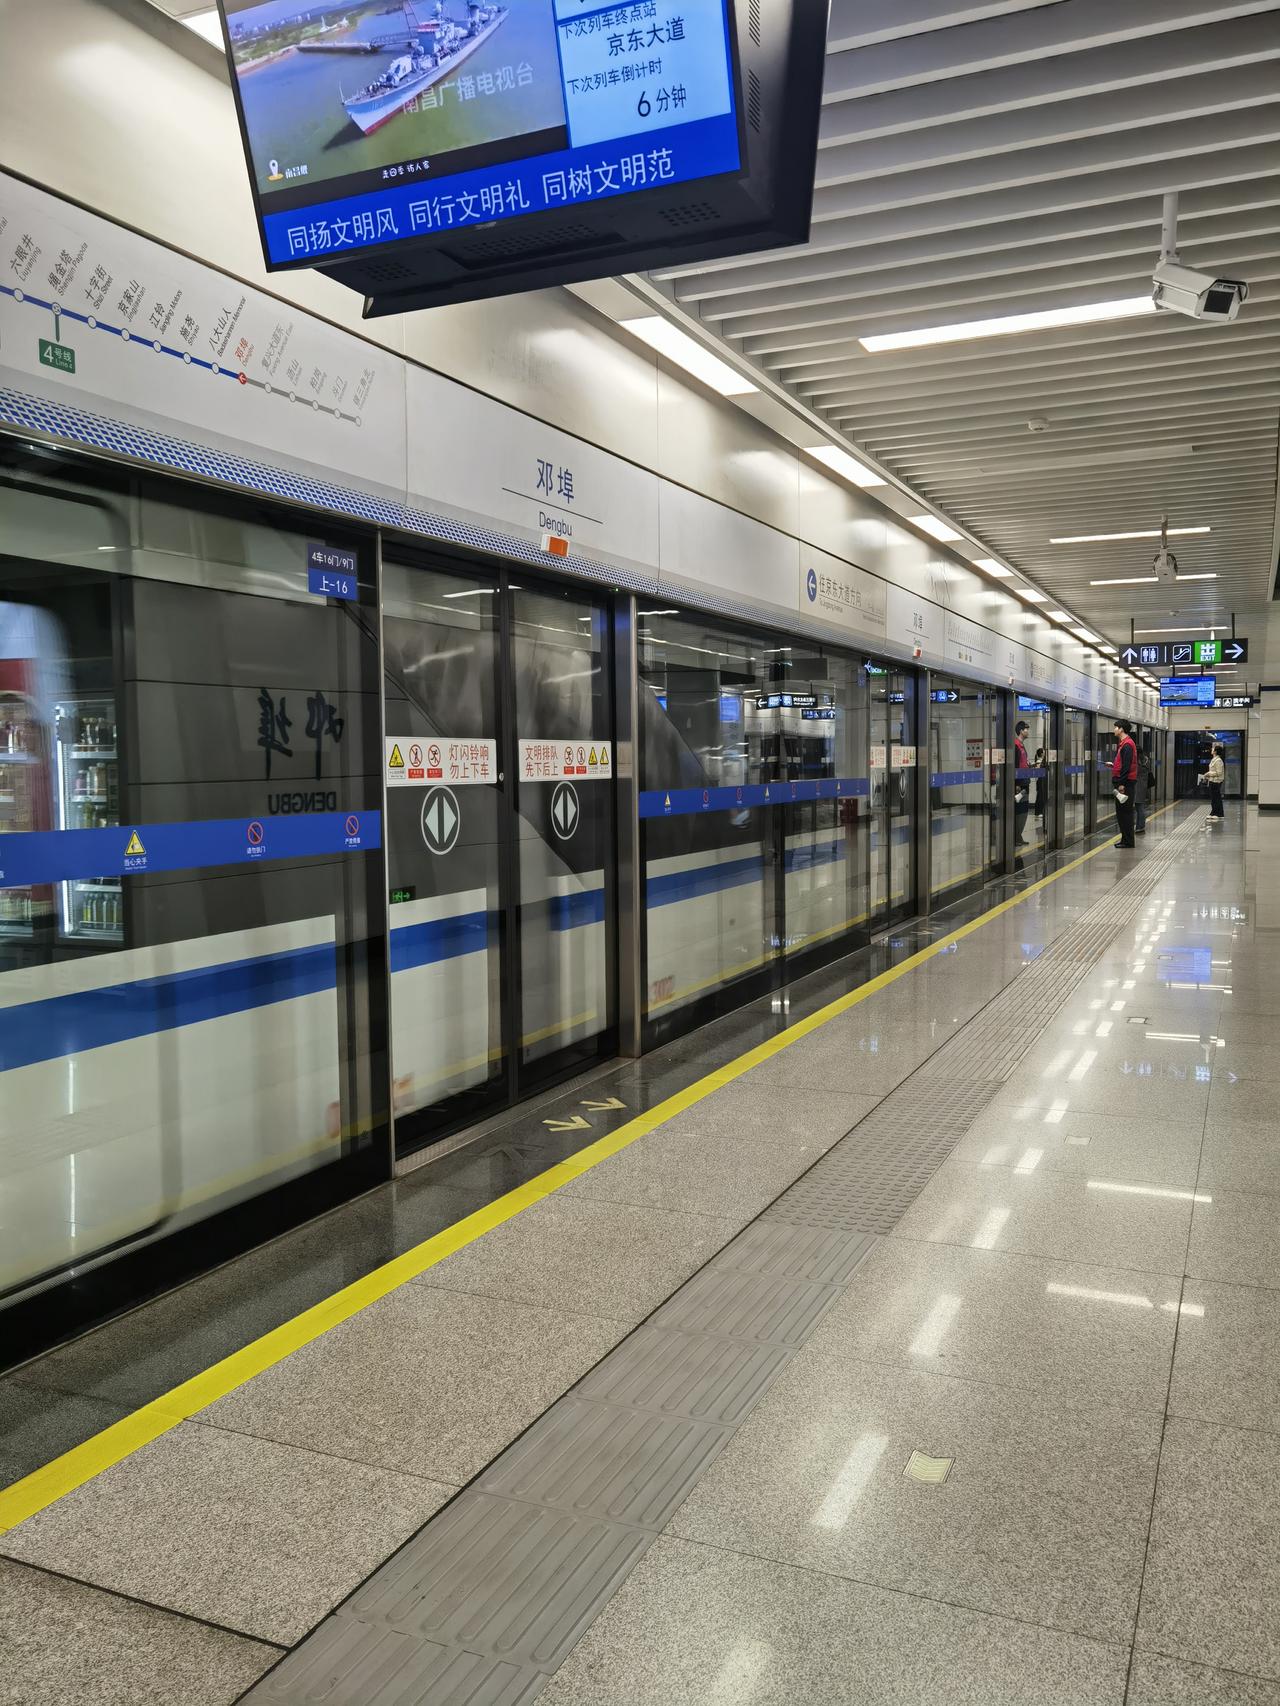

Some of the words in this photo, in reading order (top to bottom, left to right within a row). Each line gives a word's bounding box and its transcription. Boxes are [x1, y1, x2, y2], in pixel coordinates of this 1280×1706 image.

[560, 2, 657, 40] 下次列车终点站
[606, 16, 686, 57] 京东大道
[402, 61, 534, 115] 南昌广播电视台
[567, 57, 663, 95] 下次列车倒计时
[637, 91, 651, 118] 6
[656, 83, 687, 114] 分钟
[287, 207, 399, 256] 同扬文明风
[408, 180, 530, 231] 同行文明礼
[542, 148, 675, 205] 同树文明范
[10, 234, 34, 275] 六眼井
[48, 250, 73, 291] 绳金塔
[84, 264, 107, 300] 十字街
[118, 280, 140, 316] 京家山
[149, 302, 165, 329] 江铃
[208, 307, 232, 352] 八大山人
[536, 458, 575, 505] 邓埠
[539, 511, 573, 537] Dengbu
[319, 575, 348, 594] 上-16
[449, 744, 489, 761] 灯闪铃响
[525, 745, 558, 761] 文明排队
[525, 762, 558, 777] 先下后上
[450, 763, 489, 780] 勿上下车
